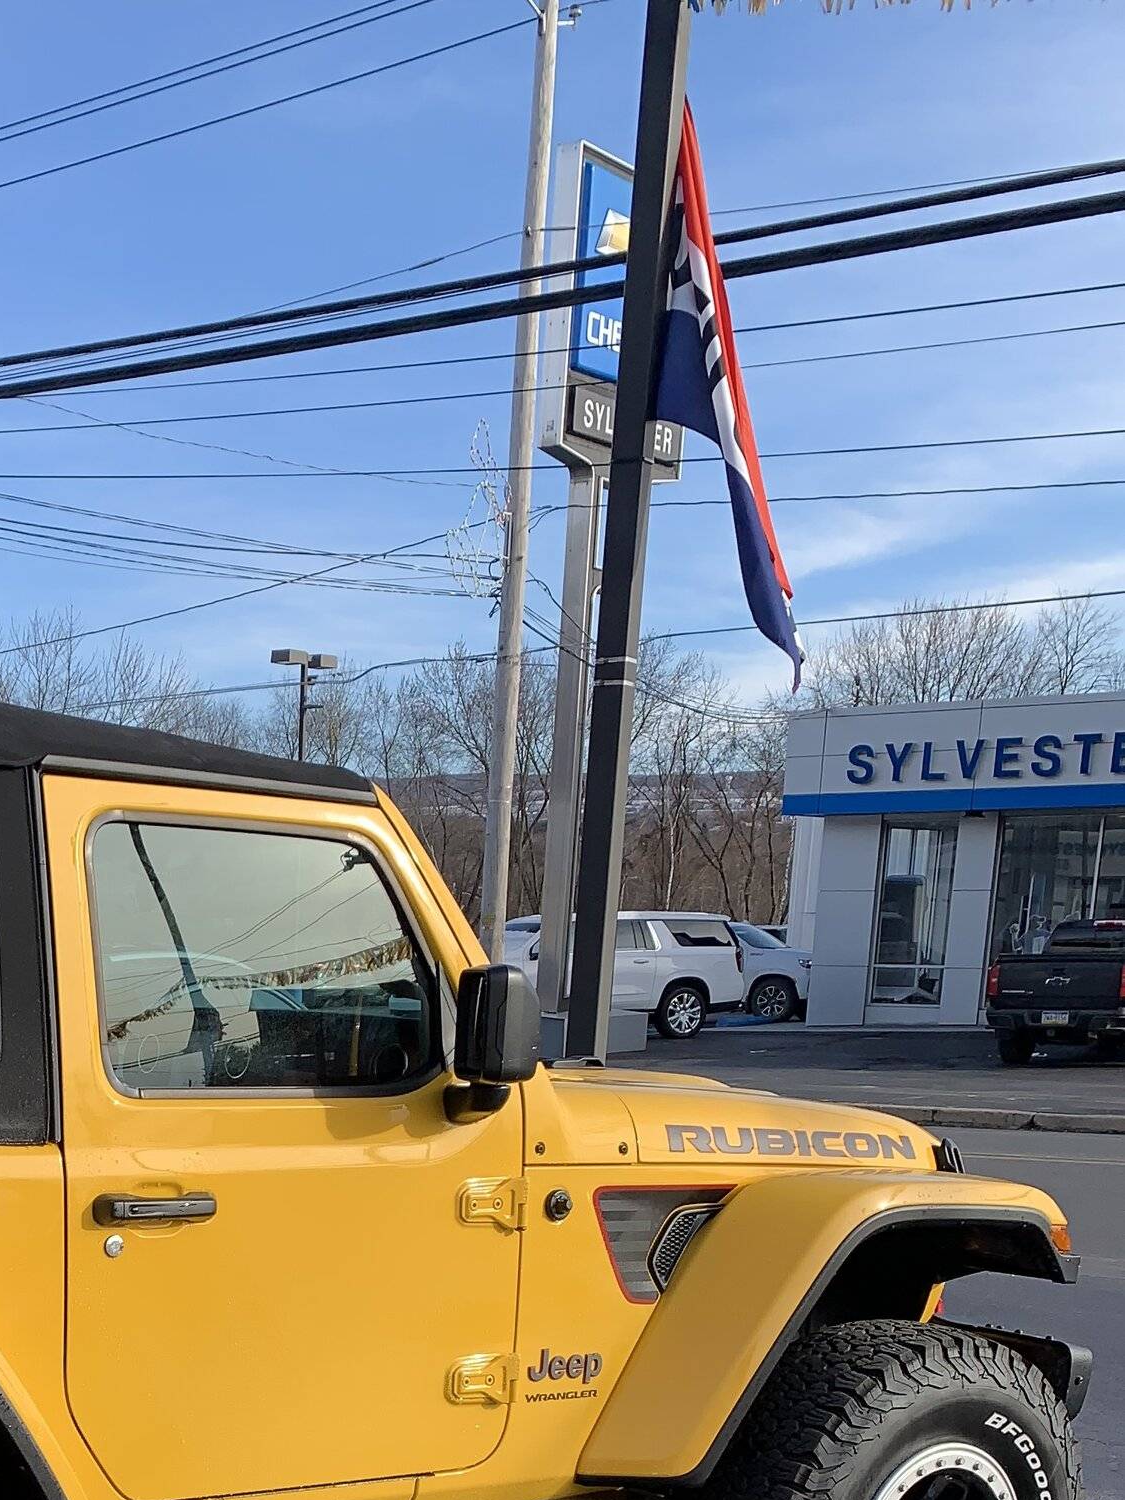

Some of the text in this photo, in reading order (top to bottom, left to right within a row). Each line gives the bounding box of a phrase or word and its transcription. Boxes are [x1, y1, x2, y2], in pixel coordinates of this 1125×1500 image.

[586, 311, 622, 353] CHE
[665, 1124, 916, 1160] RUBICON
[527, 1348, 603, 1385] Jeep
[525, 1389, 598, 1403] WRANGLER
